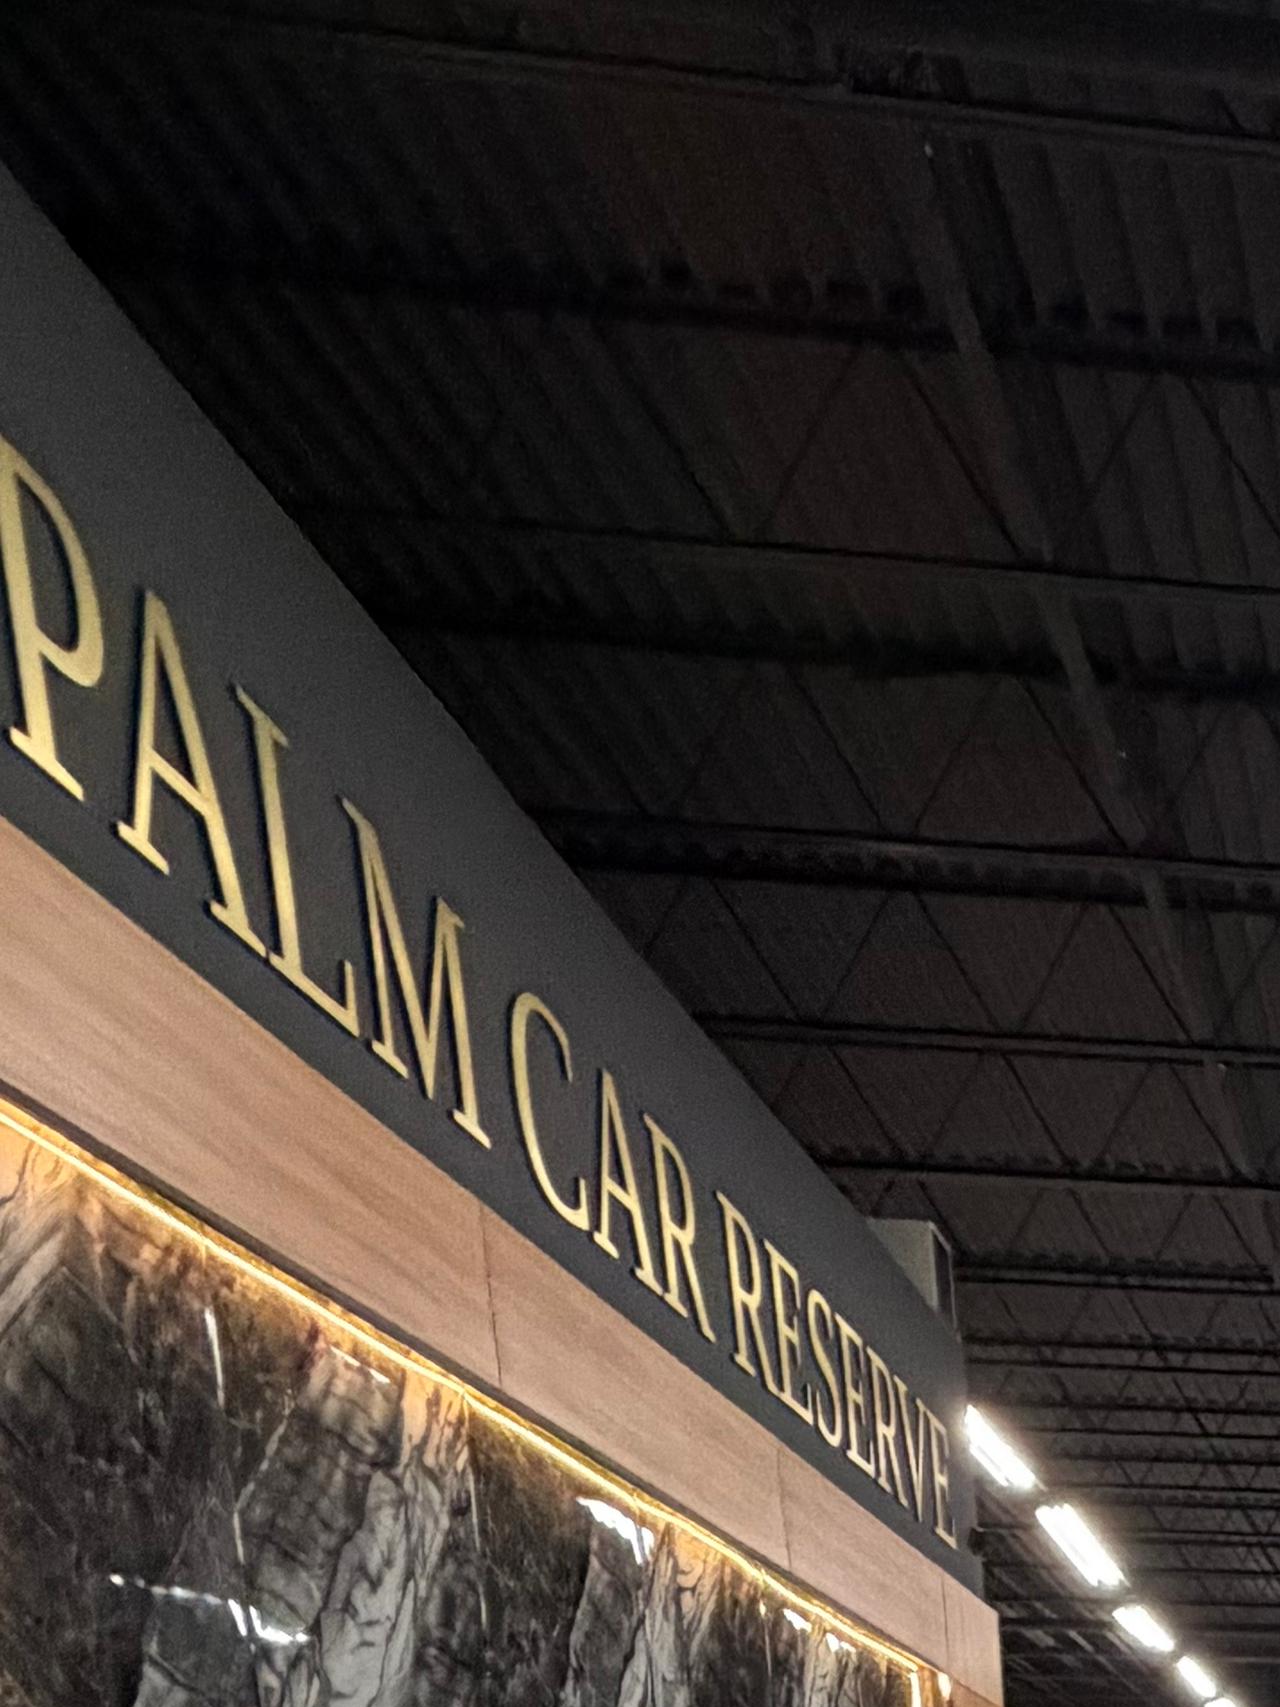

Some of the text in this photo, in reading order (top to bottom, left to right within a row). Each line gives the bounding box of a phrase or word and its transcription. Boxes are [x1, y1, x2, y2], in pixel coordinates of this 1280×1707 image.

[0, 433, 957, 1550] PALM CAR RESERVE
